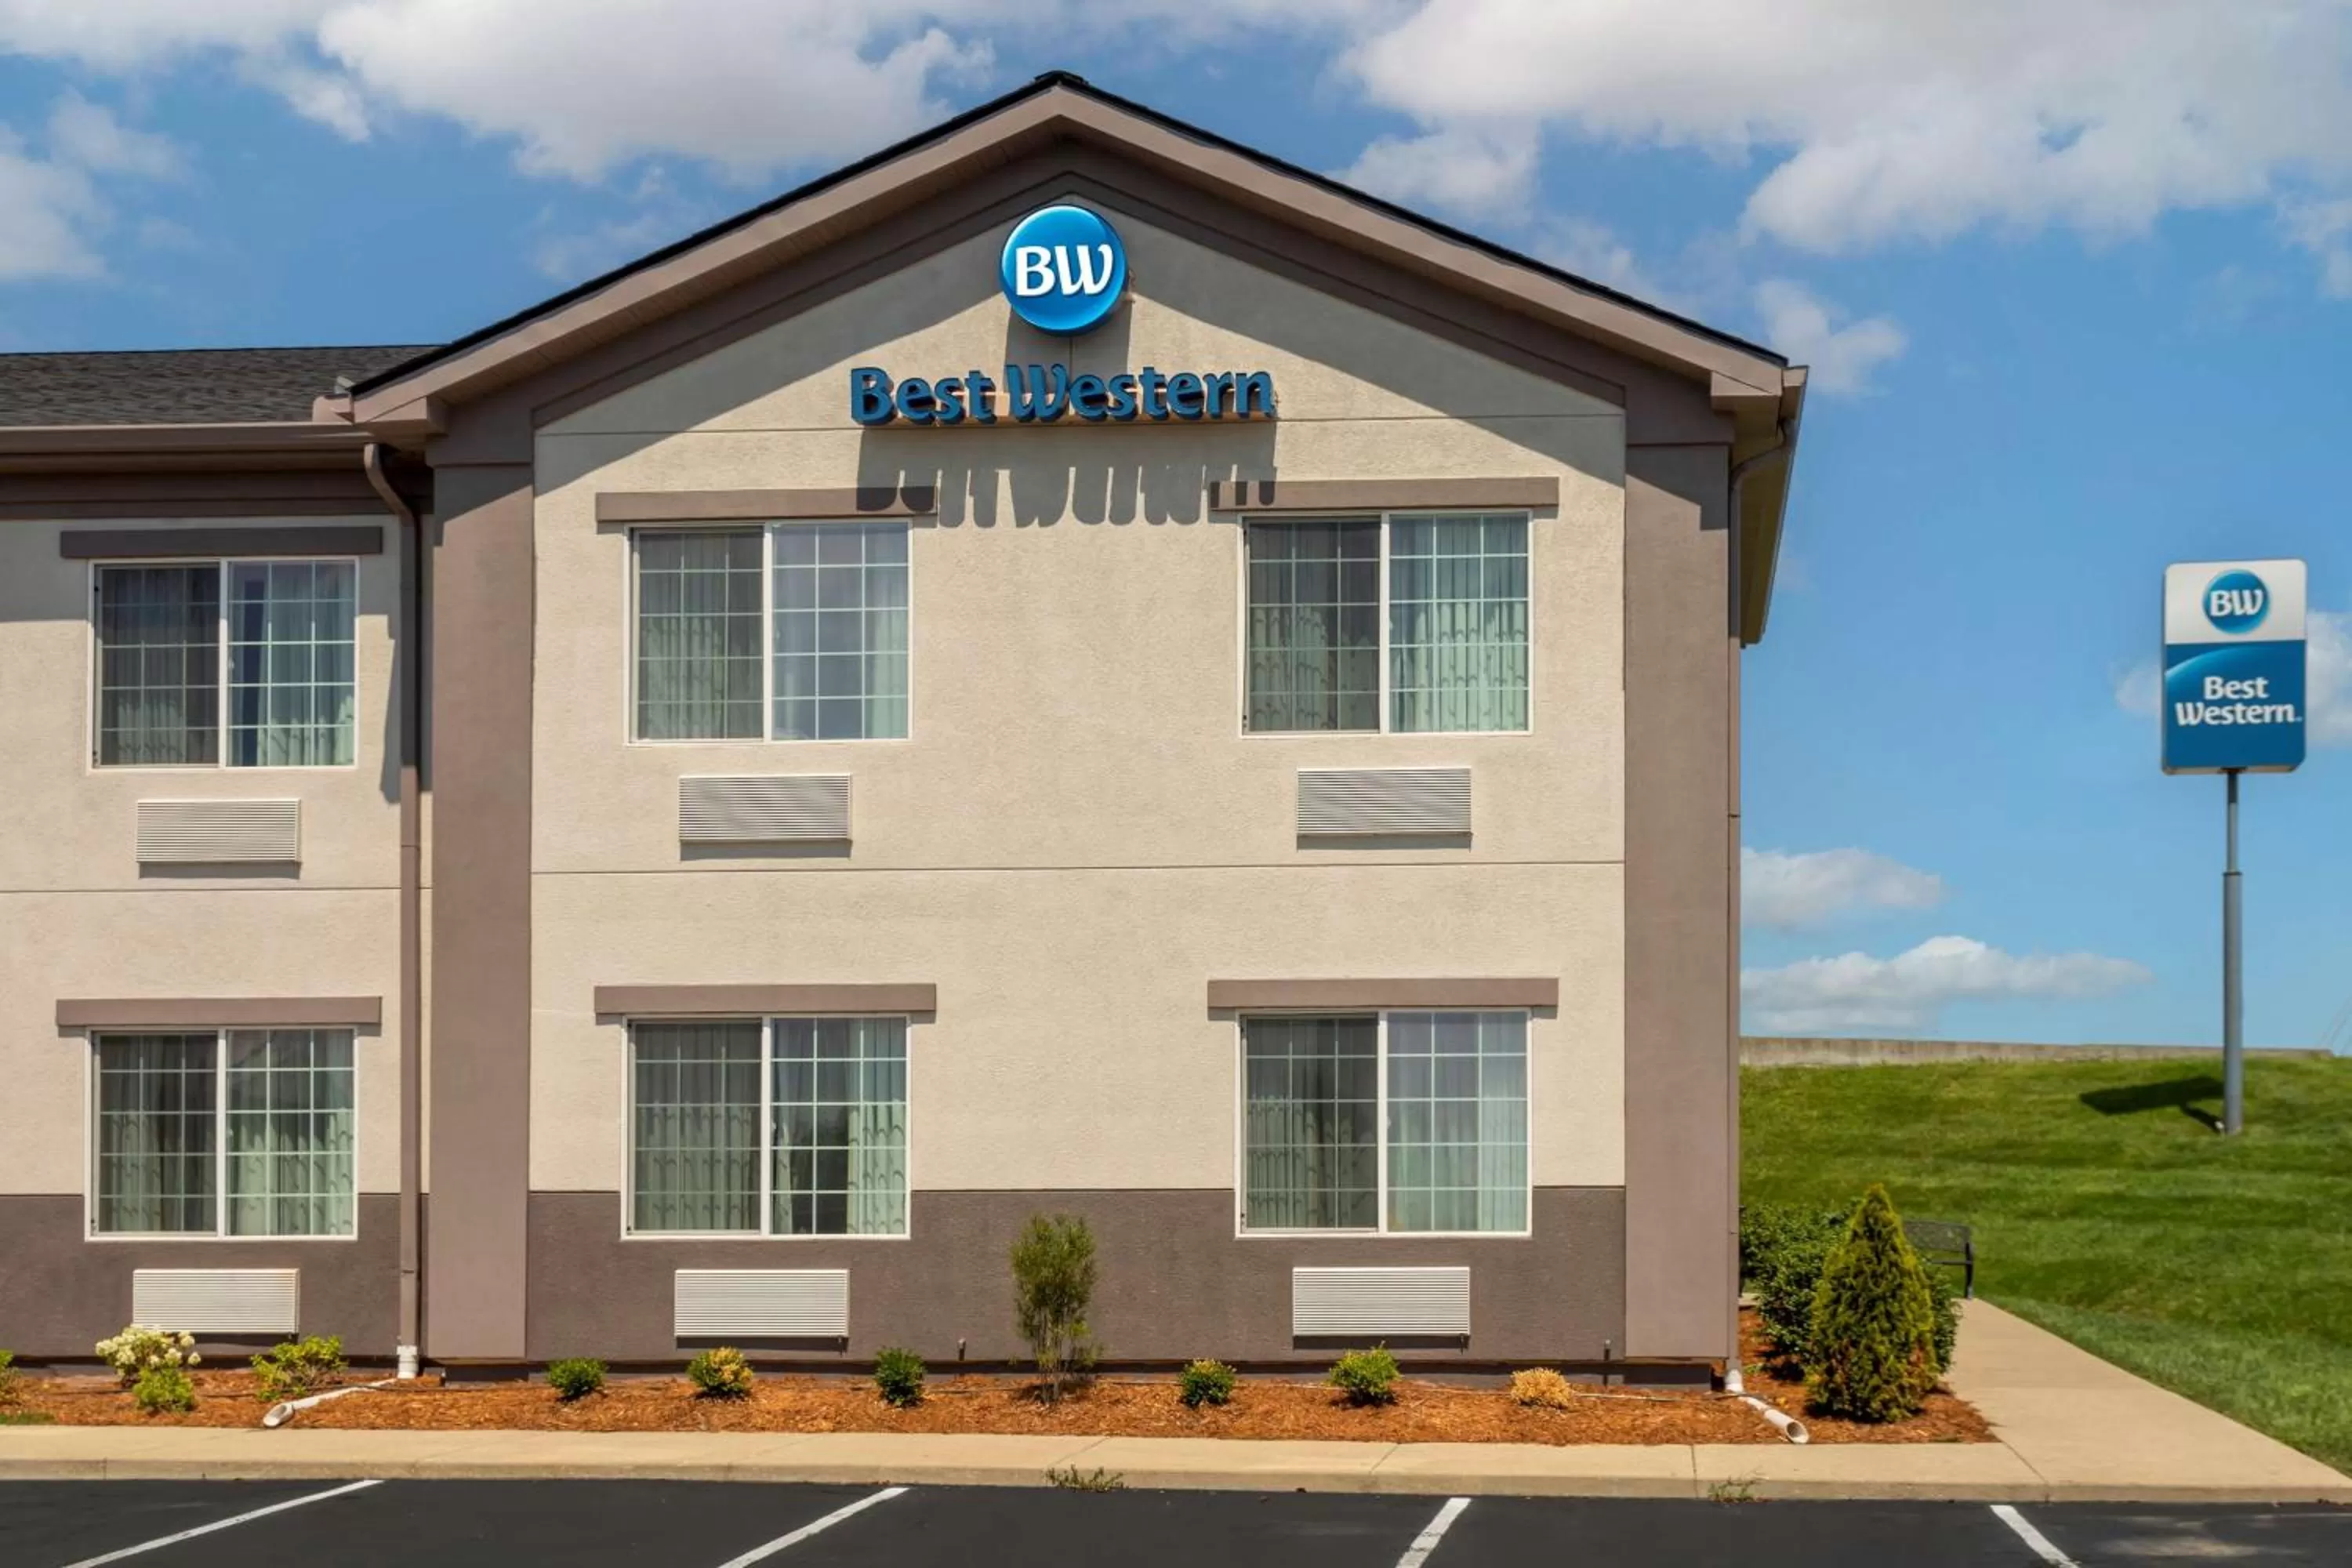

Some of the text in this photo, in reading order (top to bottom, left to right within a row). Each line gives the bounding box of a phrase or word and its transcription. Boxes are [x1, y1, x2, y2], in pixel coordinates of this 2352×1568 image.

[1015, 244, 1113, 296] BW
[851, 362, 1276, 425] Best Western
[2209, 589, 2264, 617] BW
[2204, 675, 2270, 700] Best
[2175, 701, 2296, 726] Western
